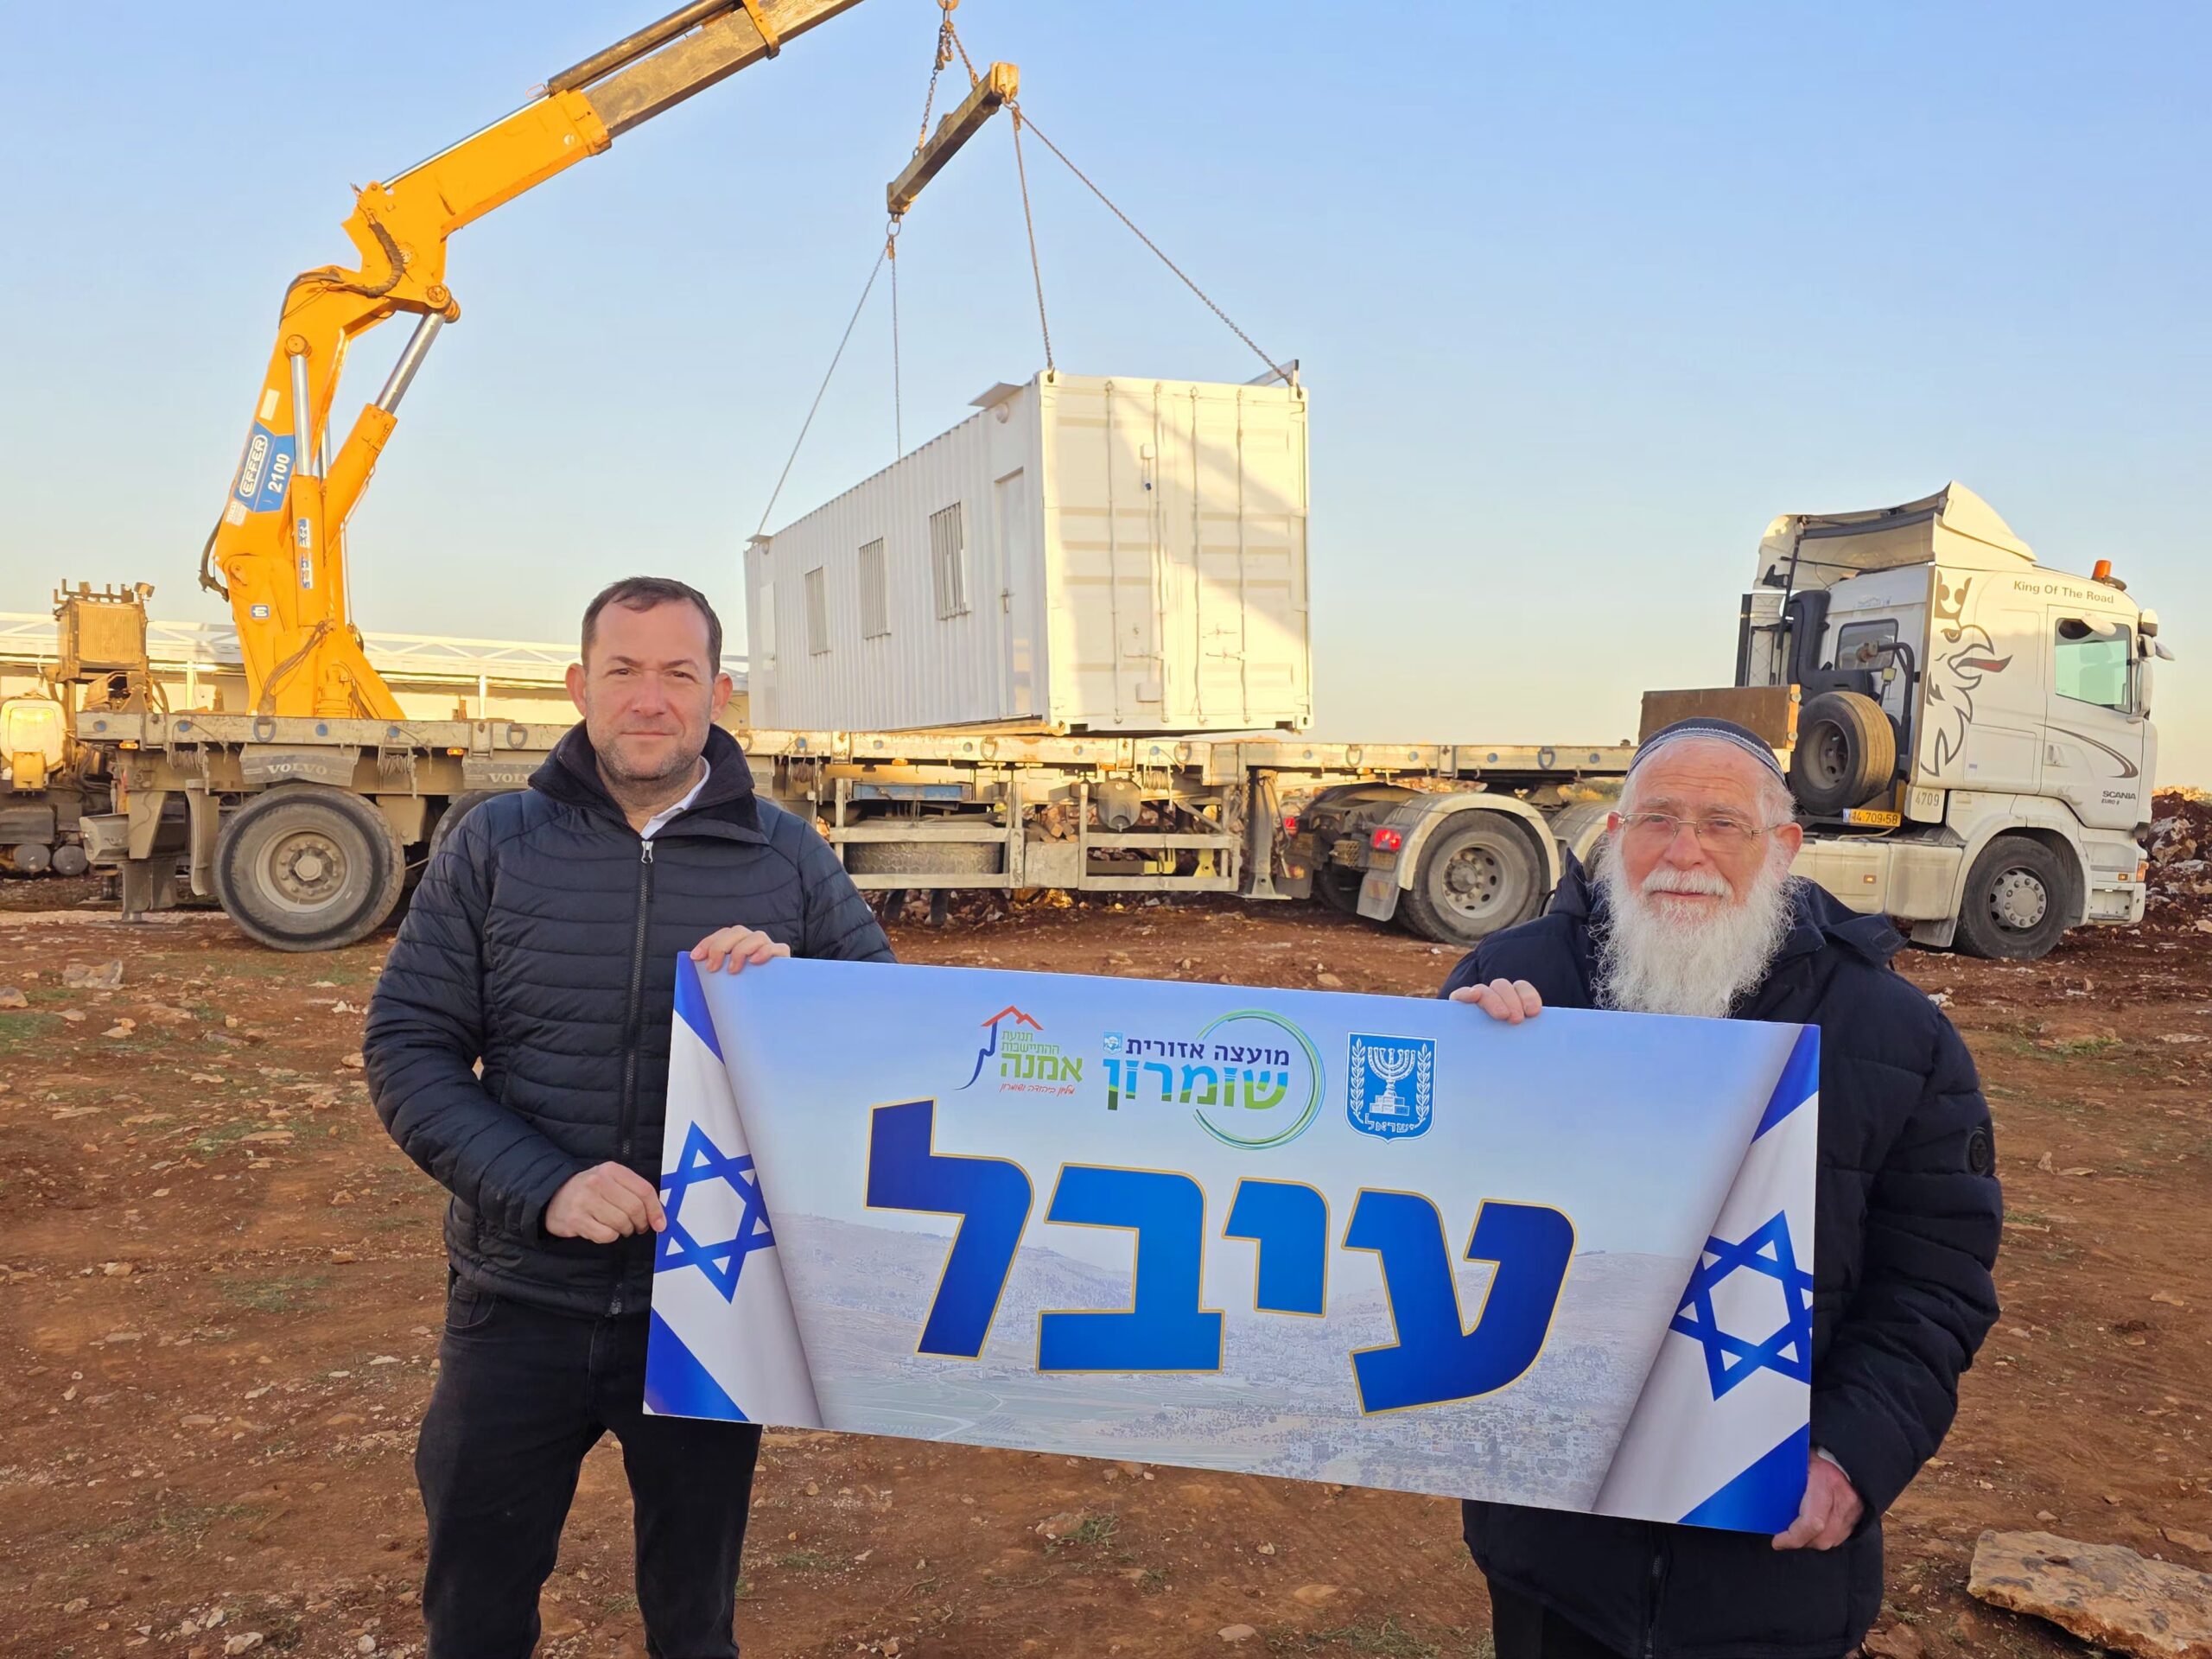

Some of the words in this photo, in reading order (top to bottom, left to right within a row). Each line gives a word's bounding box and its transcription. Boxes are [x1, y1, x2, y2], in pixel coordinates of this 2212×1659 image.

[242, 437, 266, 494] EFFER
[268, 453, 290, 493] 2100
[2013, 580, 2040, 594] King
[2044, 585, 2058, 595] Of
[2062, 588, 2083, 599] The
[2087, 591, 2114, 604] Road
[267, 763, 327, 775] VOLVO
[488, 772, 530, 783] VOL
[1915, 791, 1940, 806] 4709
[2102, 791, 2136, 800] SCANIA
[1126, 1039, 1205, 1059] אזורית
[1214, 1045, 1289, 1065] מועצה
[1001, 1052, 1083, 1083] אמנה
[1103, 1058, 1288, 1110] שומרון
[1365, 1113, 1414, 1133] ישראל
[865, 1096, 1579, 1416] עיבל
